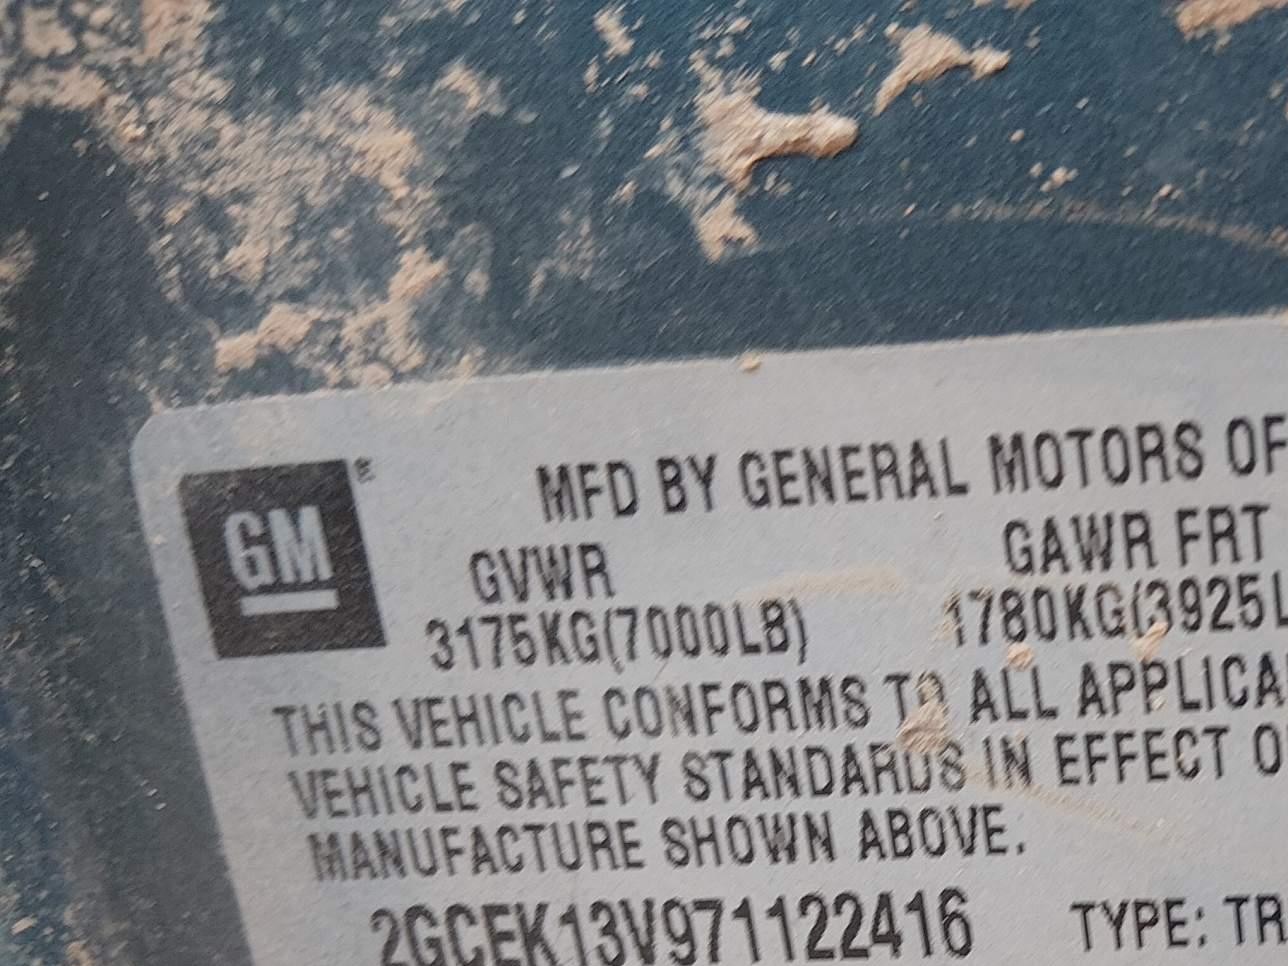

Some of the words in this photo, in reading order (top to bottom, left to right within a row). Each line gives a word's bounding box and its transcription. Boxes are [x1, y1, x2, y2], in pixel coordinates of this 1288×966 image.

[536, 461, 640, 523] MFD
[657, 455, 718, 515] BY
[739, 437, 968, 508] GENERAL
[988, 420, 1204, 495] MOTORS
[1227, 413, 1288, 477] OF
[223, 504, 334, 590] GM
[469, 543, 617, 603] GVWR
[1004, 510, 1155, 575] GAWR
[1175, 504, 1270, 566] FRT
[425, 598, 809, 673] 3175KG(7000LB)
[273, 703, 382, 757] THIS
[399, 688, 586, 750] VEHICLE
[604, 675, 870, 741] CONFORMS
[969, 662, 1058, 726] ALL
[289, 759, 478, 819] VEHICLE
[495, 752, 660, 810] SAFETY
[682, 740, 966, 802] STANDARDS
[982, 735, 1032, 791] IN
[1055, 725, 1229, 786] EFFECT
[307, 819, 644, 882] MANUFACTURE
[662, 811, 835, 871] SHOWN
[857, 802, 1025, 862] ABOVE.
[1070, 899, 1208, 953] TYPE:
